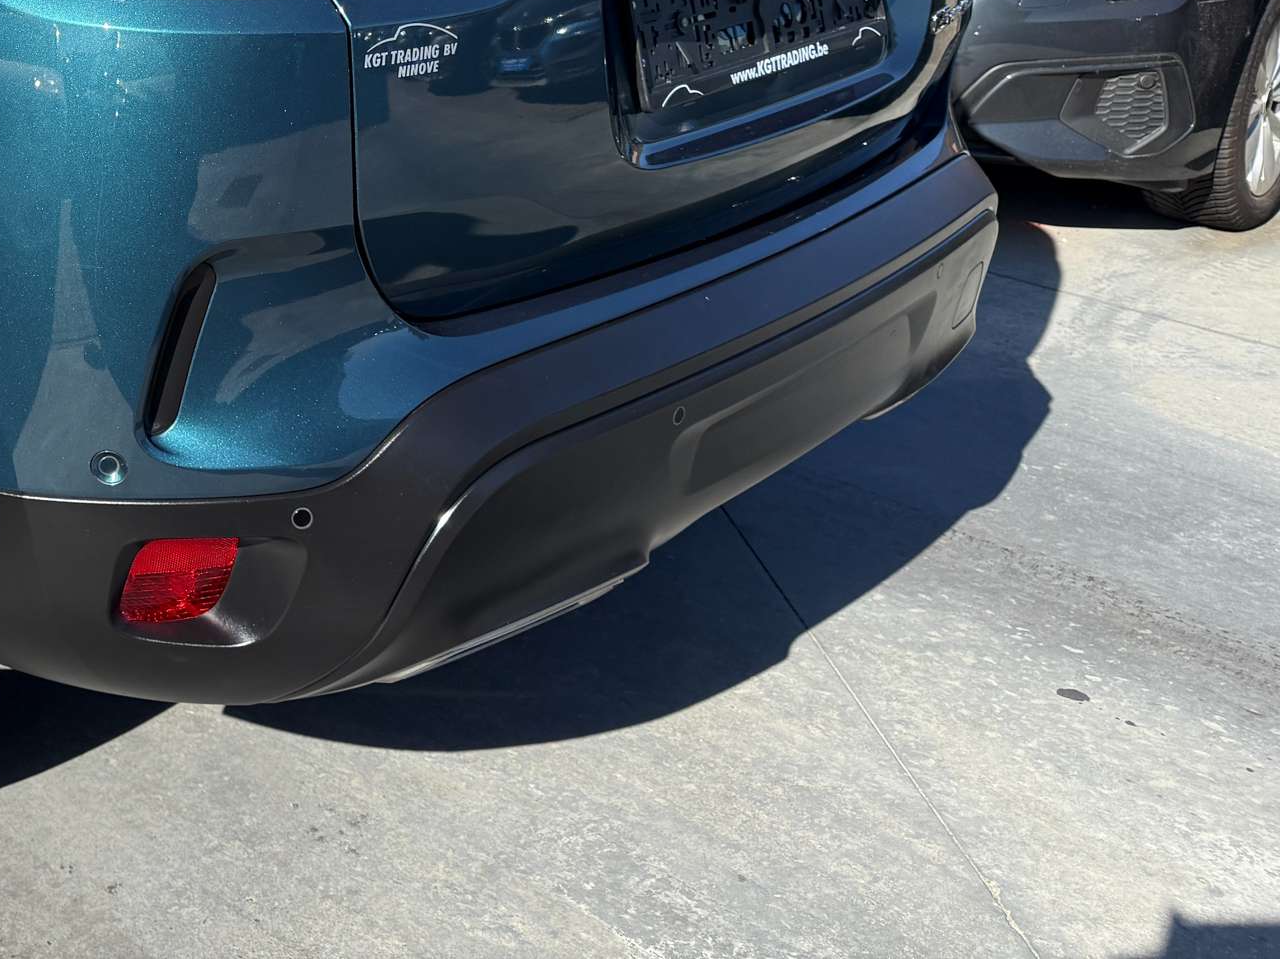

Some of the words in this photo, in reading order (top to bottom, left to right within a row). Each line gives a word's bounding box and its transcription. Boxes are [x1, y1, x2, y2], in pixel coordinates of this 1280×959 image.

[364, 52, 388, 69] KGT
[391, 44, 440, 65] TRADING
[443, 42, 458, 56] BV
[397, 60, 440, 78] NINOVE
[730, 41, 829, 85] www.KGTTRADING.be
